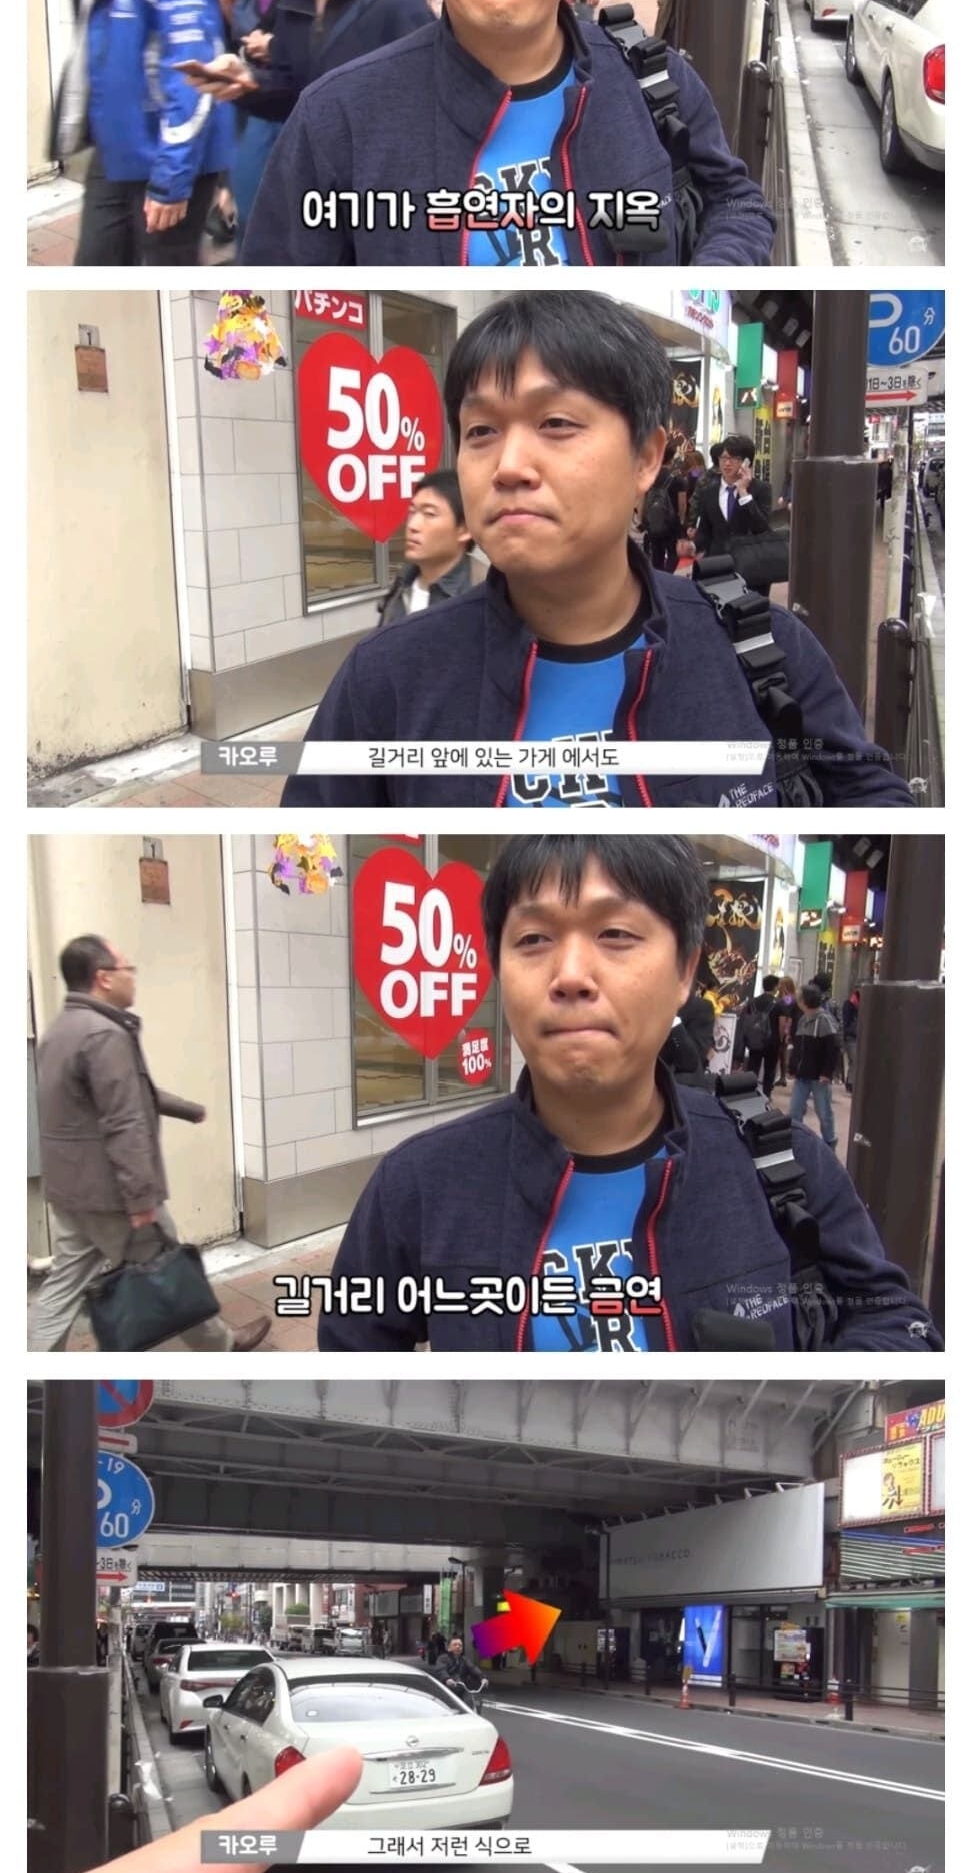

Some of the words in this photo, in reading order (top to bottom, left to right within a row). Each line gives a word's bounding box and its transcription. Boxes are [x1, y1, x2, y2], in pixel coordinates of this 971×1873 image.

[889, 326, 921, 355] 60
[326, 366, 426, 451] 50%
[327, 453, 426, 504] OFF
[380, 881, 477, 969] 50%
[380, 969, 477, 1018] OFF
[462, 1054, 492, 1075] 100%
[100, 1513, 129, 1538] 60
